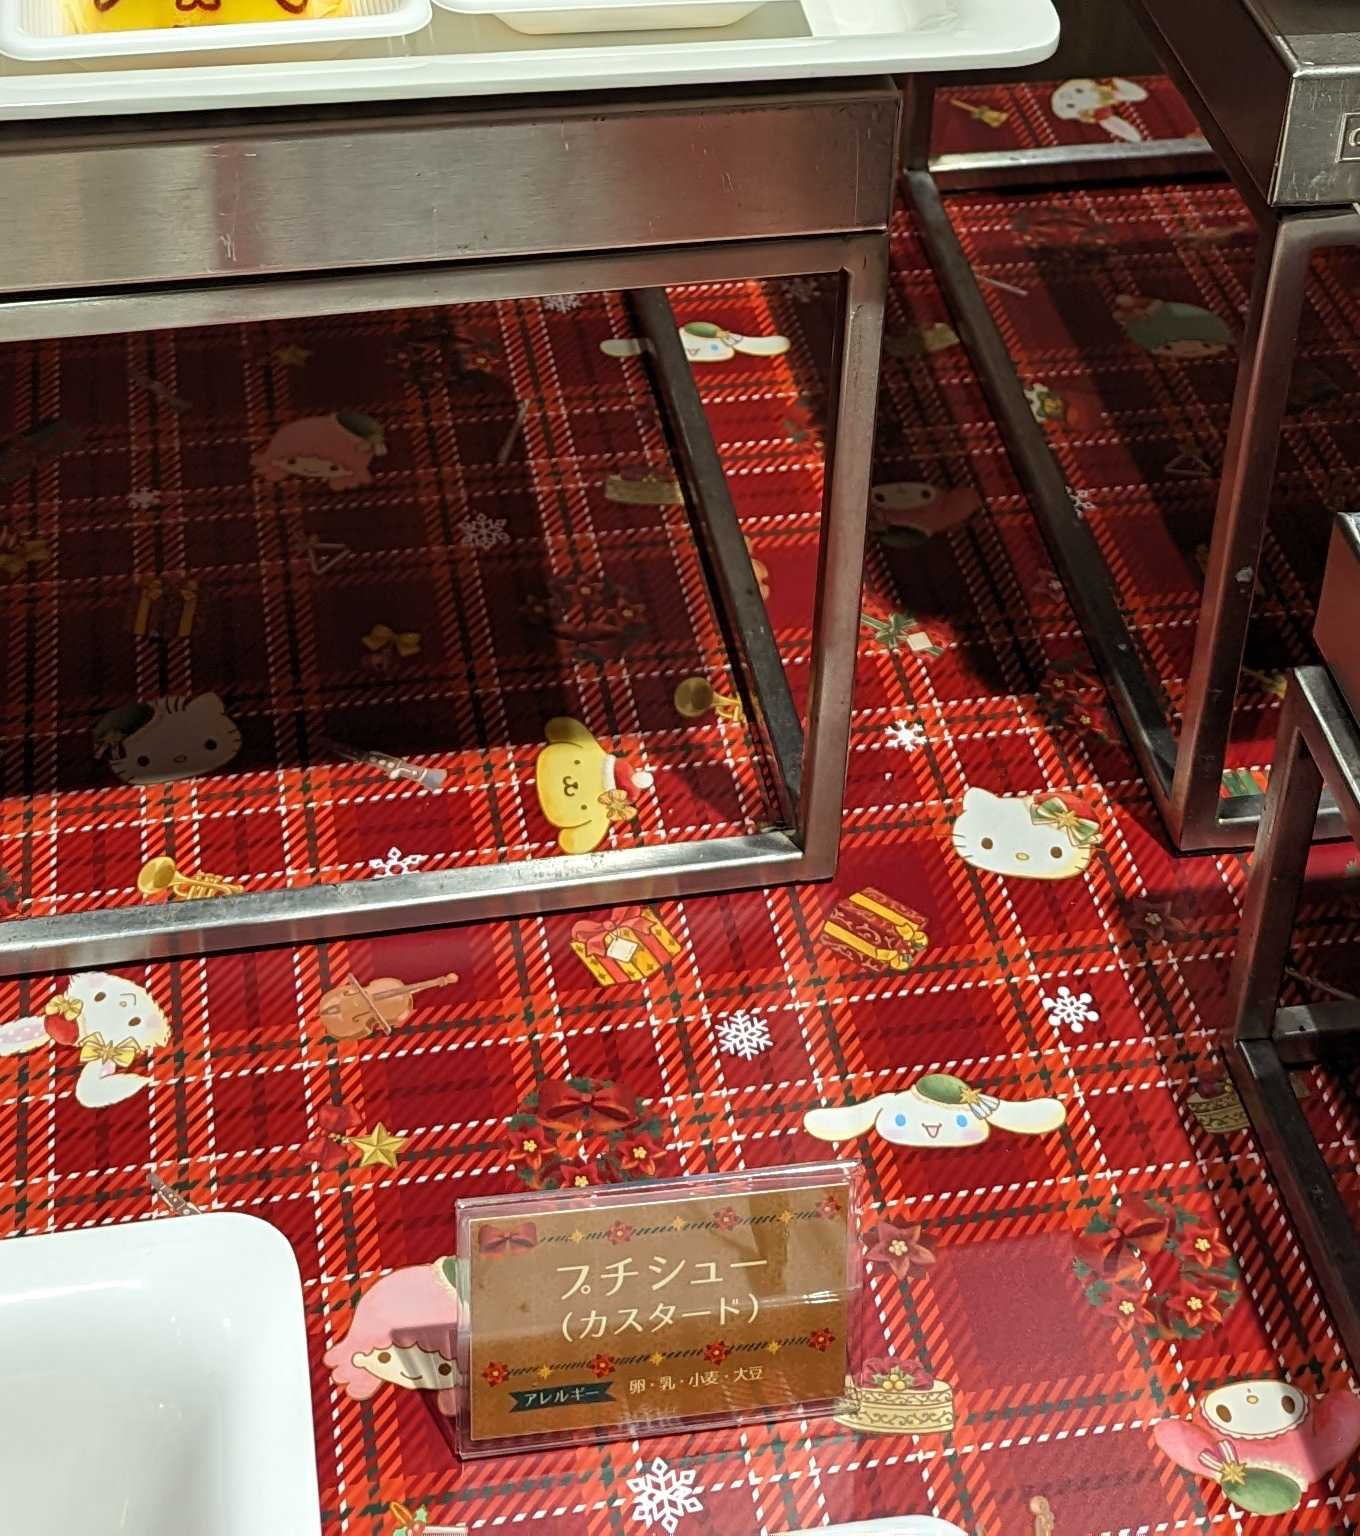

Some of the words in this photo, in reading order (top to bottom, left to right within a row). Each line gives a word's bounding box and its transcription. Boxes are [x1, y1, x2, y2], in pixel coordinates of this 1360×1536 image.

[557, 1255, 768, 1300] プチシュー
[525, 1387, 600, 1407] アレルギー
